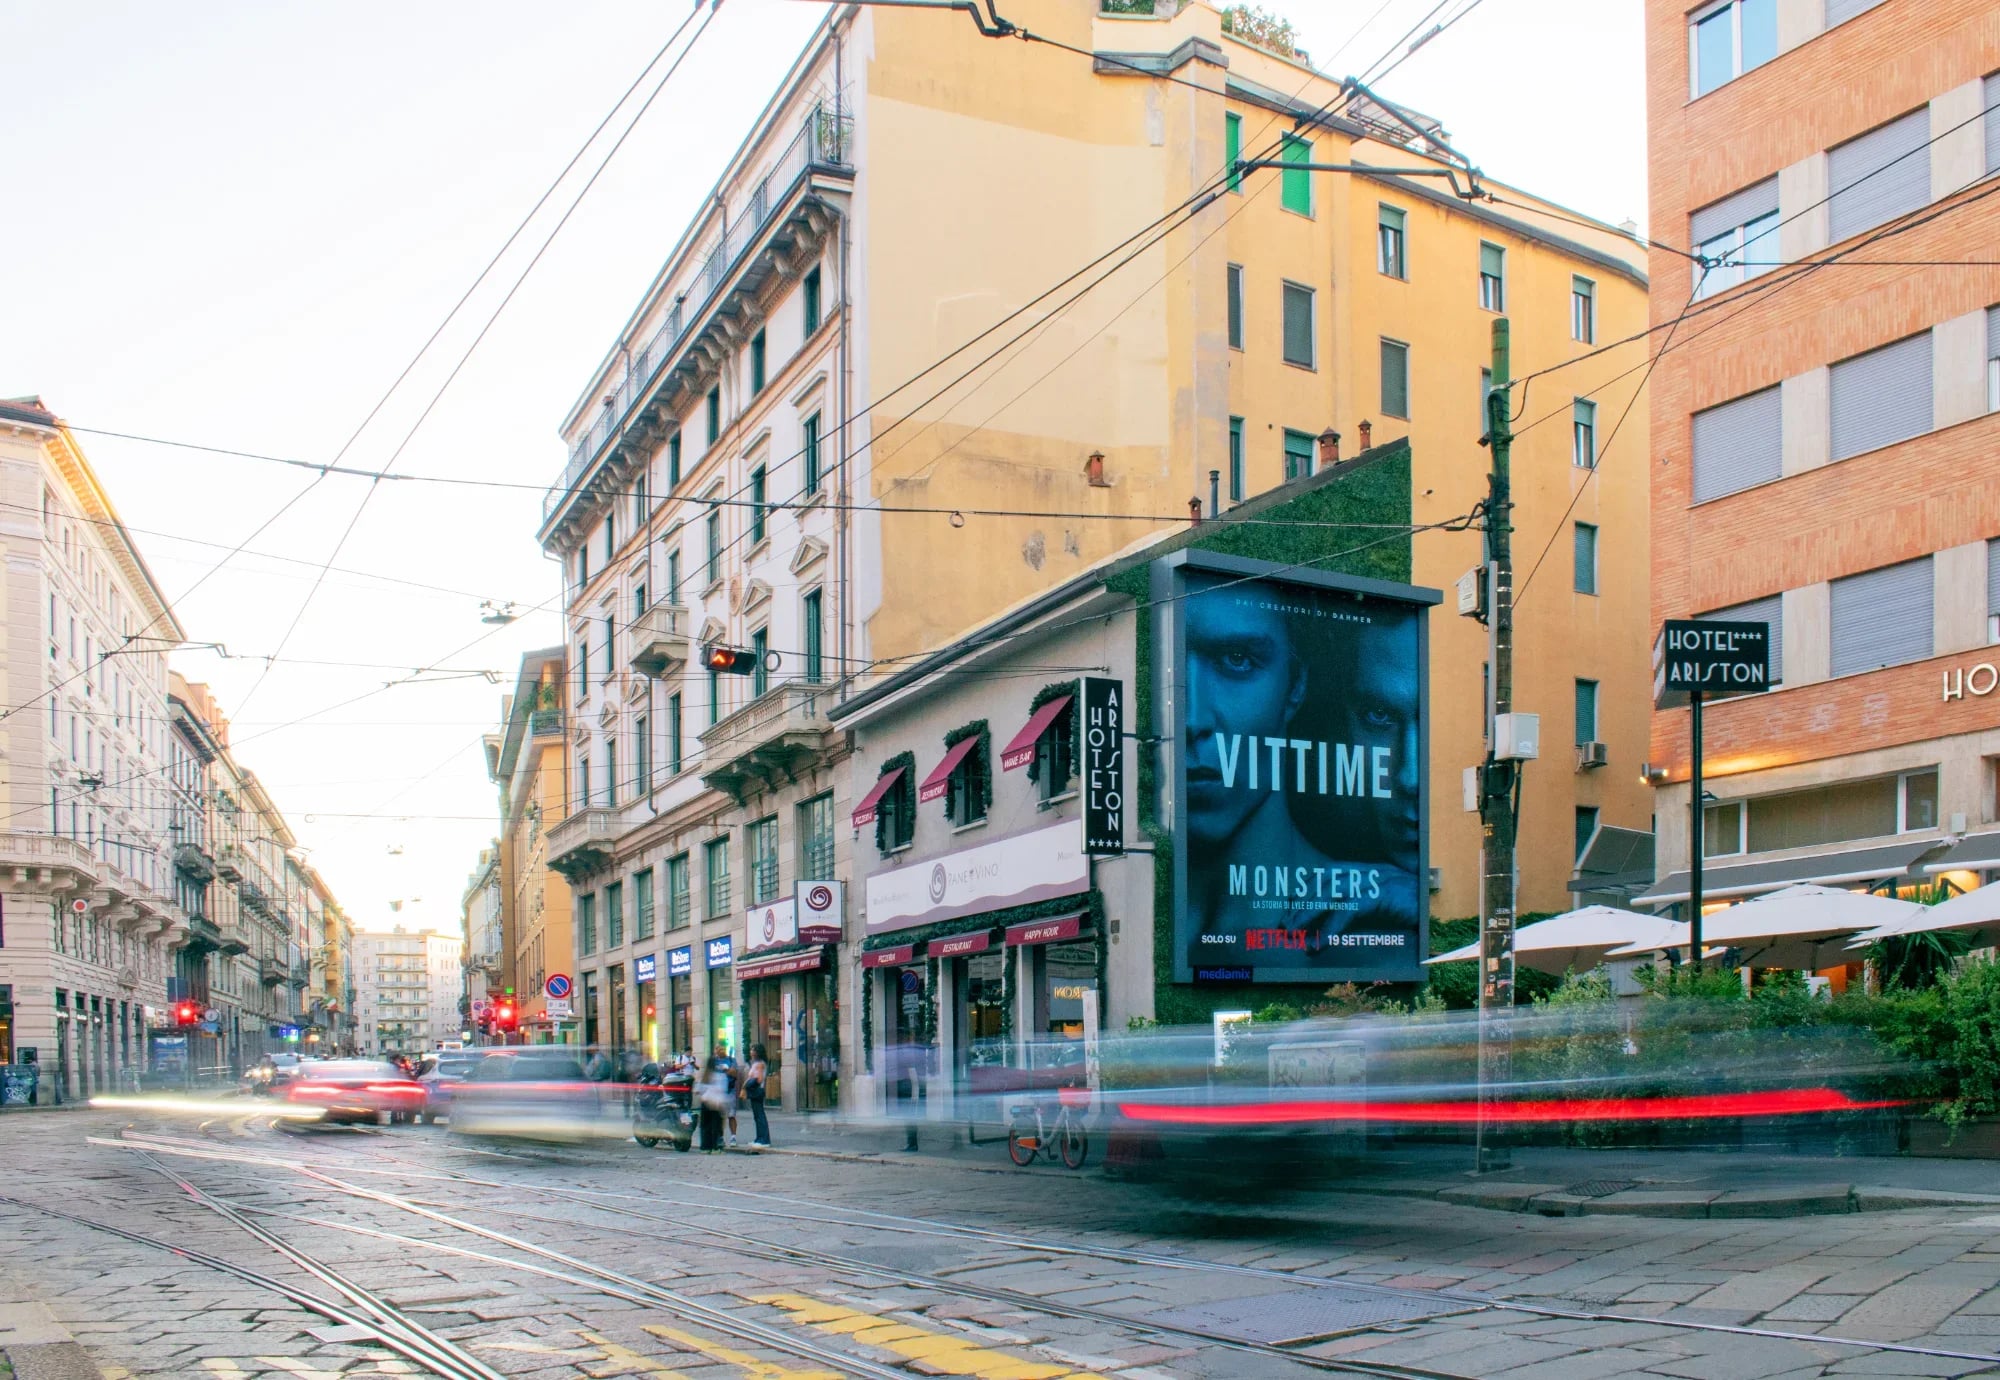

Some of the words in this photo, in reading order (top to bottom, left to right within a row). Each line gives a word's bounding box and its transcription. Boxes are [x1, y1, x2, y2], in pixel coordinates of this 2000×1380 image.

[1260, 602, 1310, 615] CREATORI
[1333, 612, 1371, 624] DAHMER
[1669, 630, 1739, 651] HOTEL
[1670, 662, 1763, 683] ARISTON
[1004, 755, 1019, 768] WINE
[1089, 707, 1105, 809] HOTEL
[1106, 688, 1121, 831] ARISTON
[1216, 733, 1391, 798] VITTIME
[1229, 864, 1380, 899] MONSTERS
[1253, 901, 1260, 909] LA
[1262, 901, 1282, 909] STORIA
[1292, 902, 1305, 910] LYLE
[1307, 902, 1314, 910] ED
[1315, 902, 1328, 910] ERIK
[1025, 929, 1042, 940] HAPPY
[1043, 926, 1059, 937] HOUR
[1202, 935, 1223, 944] SOLO
[1225, 935, 1236, 944] SU
[1246, 929, 1307, 950] NETFLIX
[1328, 935, 1339, 946] 19
[1342, 935, 1404, 946] SETTEMBRE
[943, 941, 973, 953] RESTAURANT
[1200, 968, 1249, 979] mediamix
